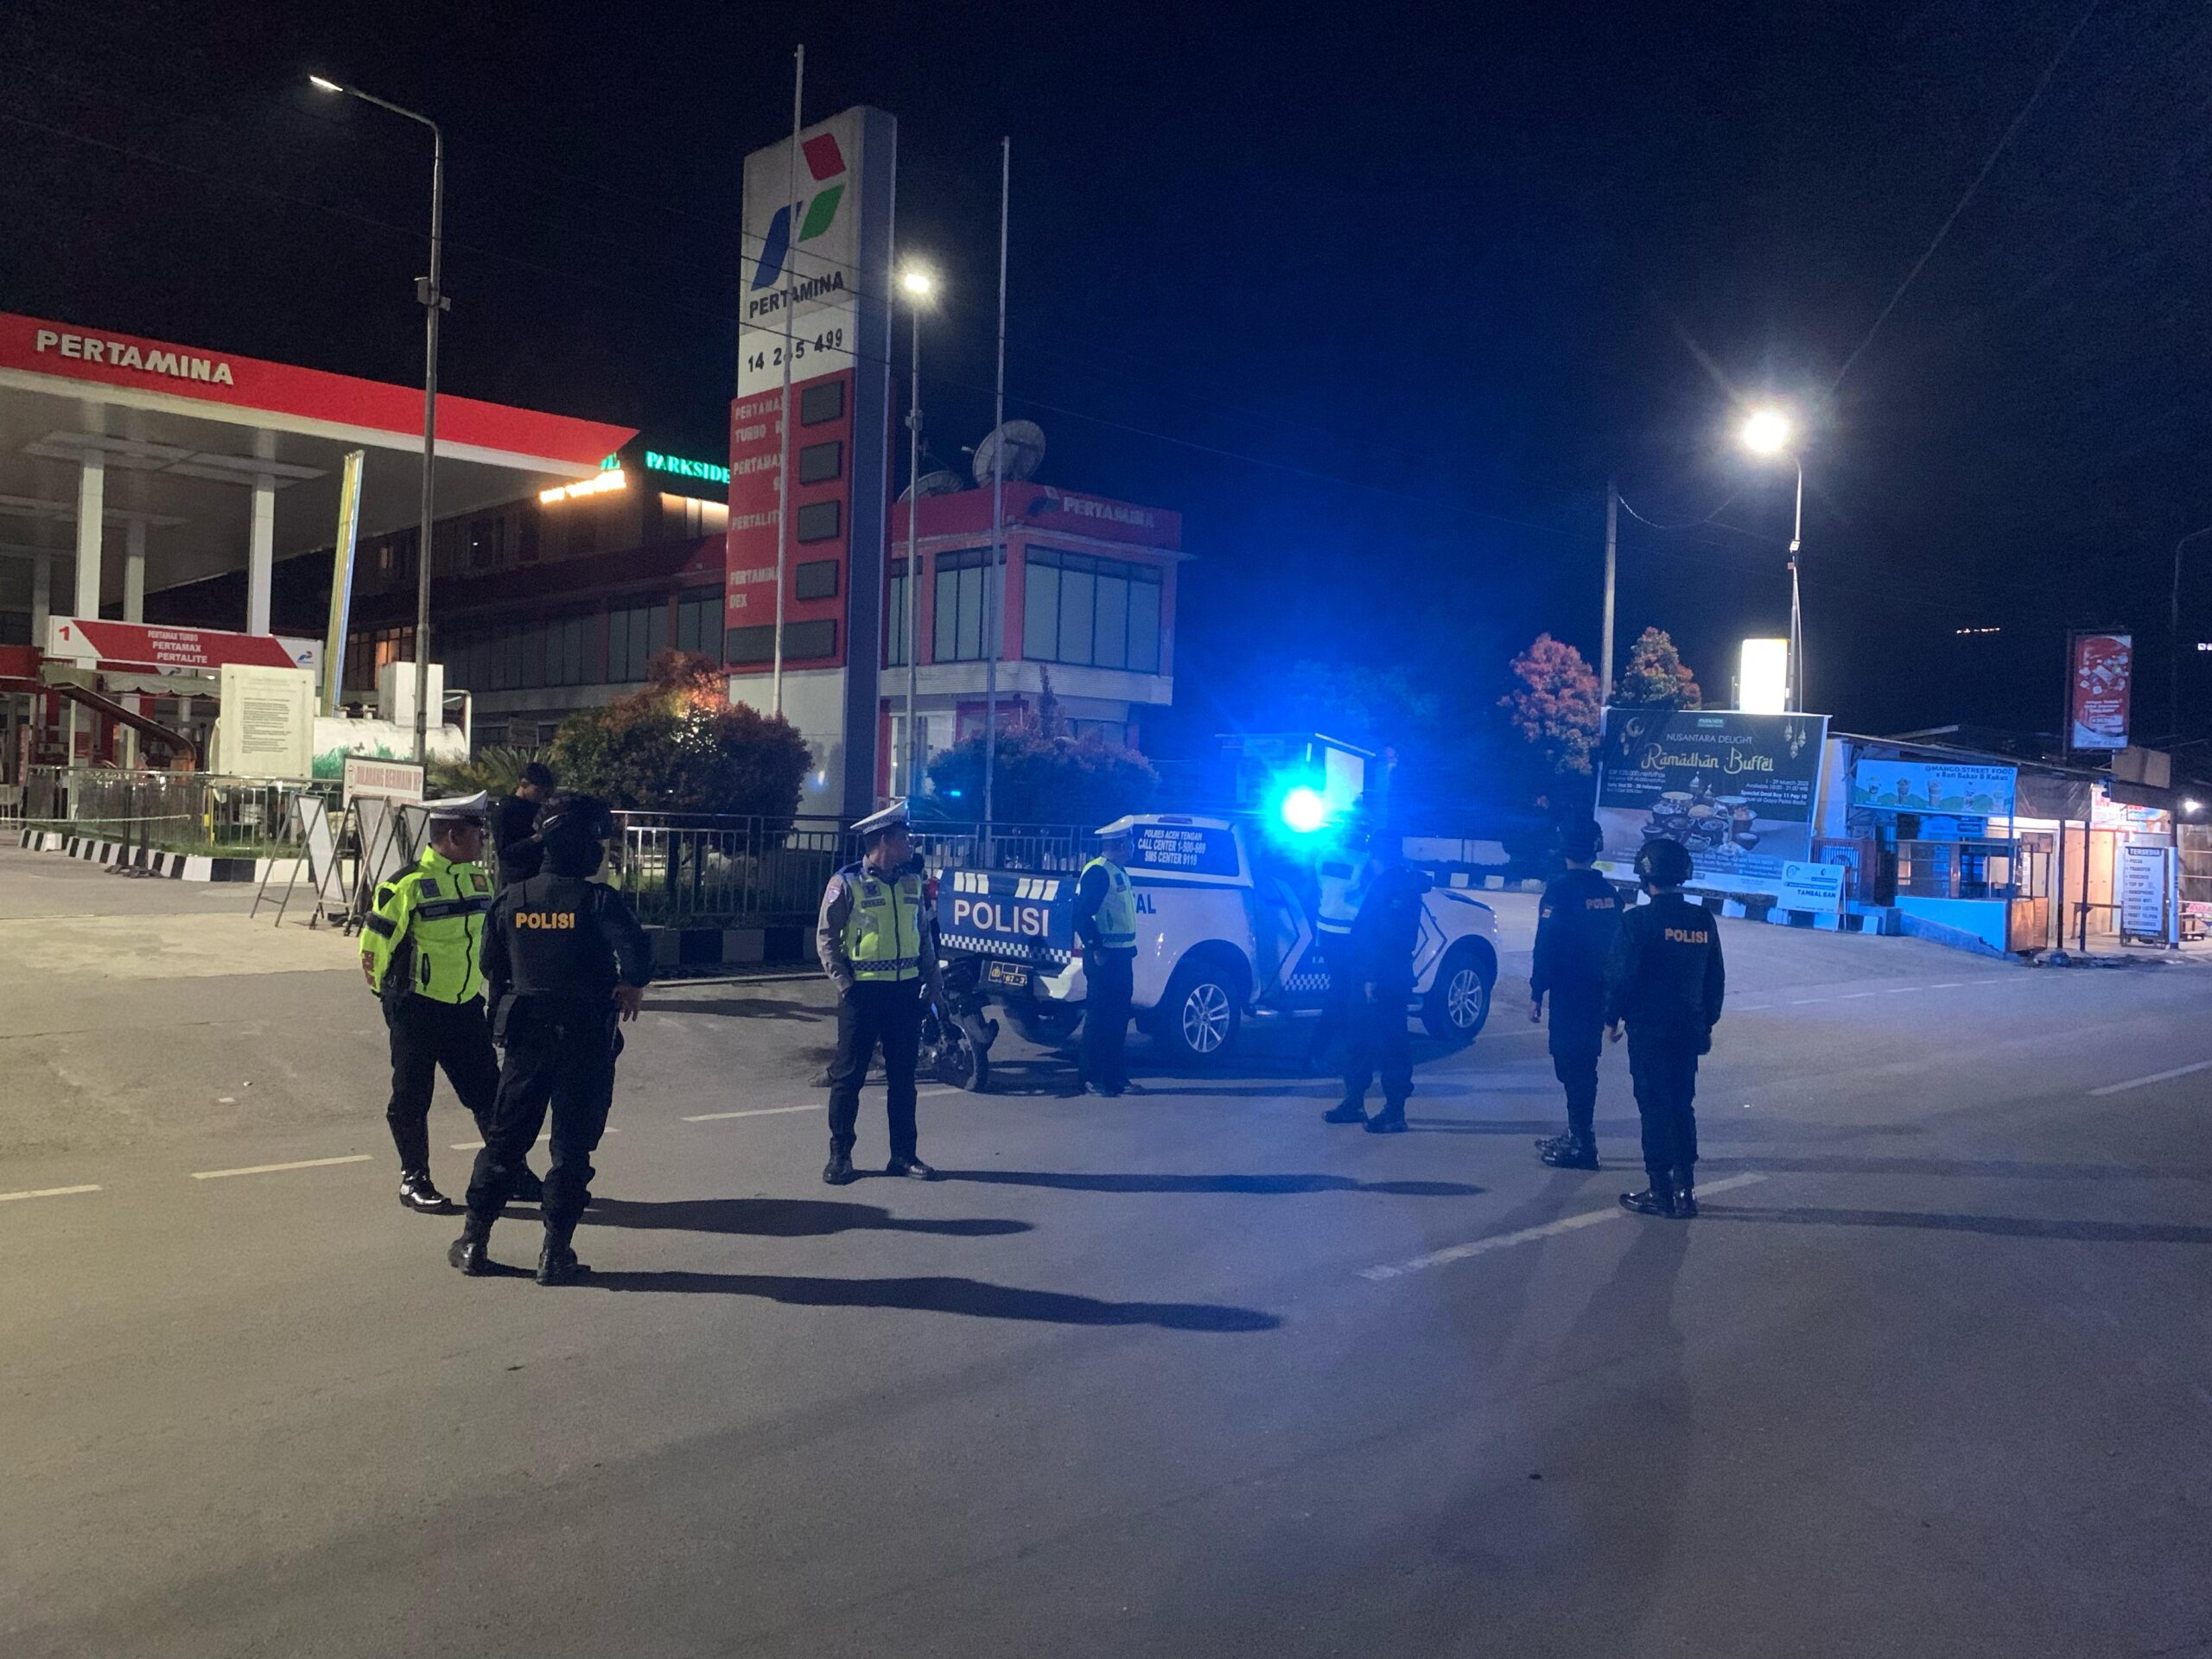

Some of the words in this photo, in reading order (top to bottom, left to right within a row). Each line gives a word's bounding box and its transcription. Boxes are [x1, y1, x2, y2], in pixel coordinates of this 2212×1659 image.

[750, 271, 844, 319] PERTAMINA
[36, 329, 234, 385] PERTAMINA
[748, 352, 765, 372] 14
[773, 340, 804, 365] 25
[814, 328, 842, 353] 499
[734, 397, 784, 420] PERTAMA
[645, 450, 730, 484] PARKSIDE
[732, 509, 780, 531] PERTALIT
[60, 626, 70, 641] 1
[152, 641, 201, 652] PERTAMAX
[156, 652, 207, 664] PERTALITE
[1667, 733, 1716, 742] NUSANTARA
[1718, 735, 1752, 745] DELIGHT
[1144, 829, 1165, 839] POLRES
[1165, 830, 1180, 839] ACEH
[1180, 831, 1203, 842] TENGAH
[1138, 838, 1153, 849] CALL
[1154, 840, 1177, 852] CENTER
[1145, 851, 1157, 862] SMS
[1158, 852, 1182, 864] CENTER
[1135, 893, 1157, 914] AL
[516, 912, 575, 929] POLISI
[954, 899, 1049, 938] POLISI
[1664, 928, 1708, 944] POLISI
